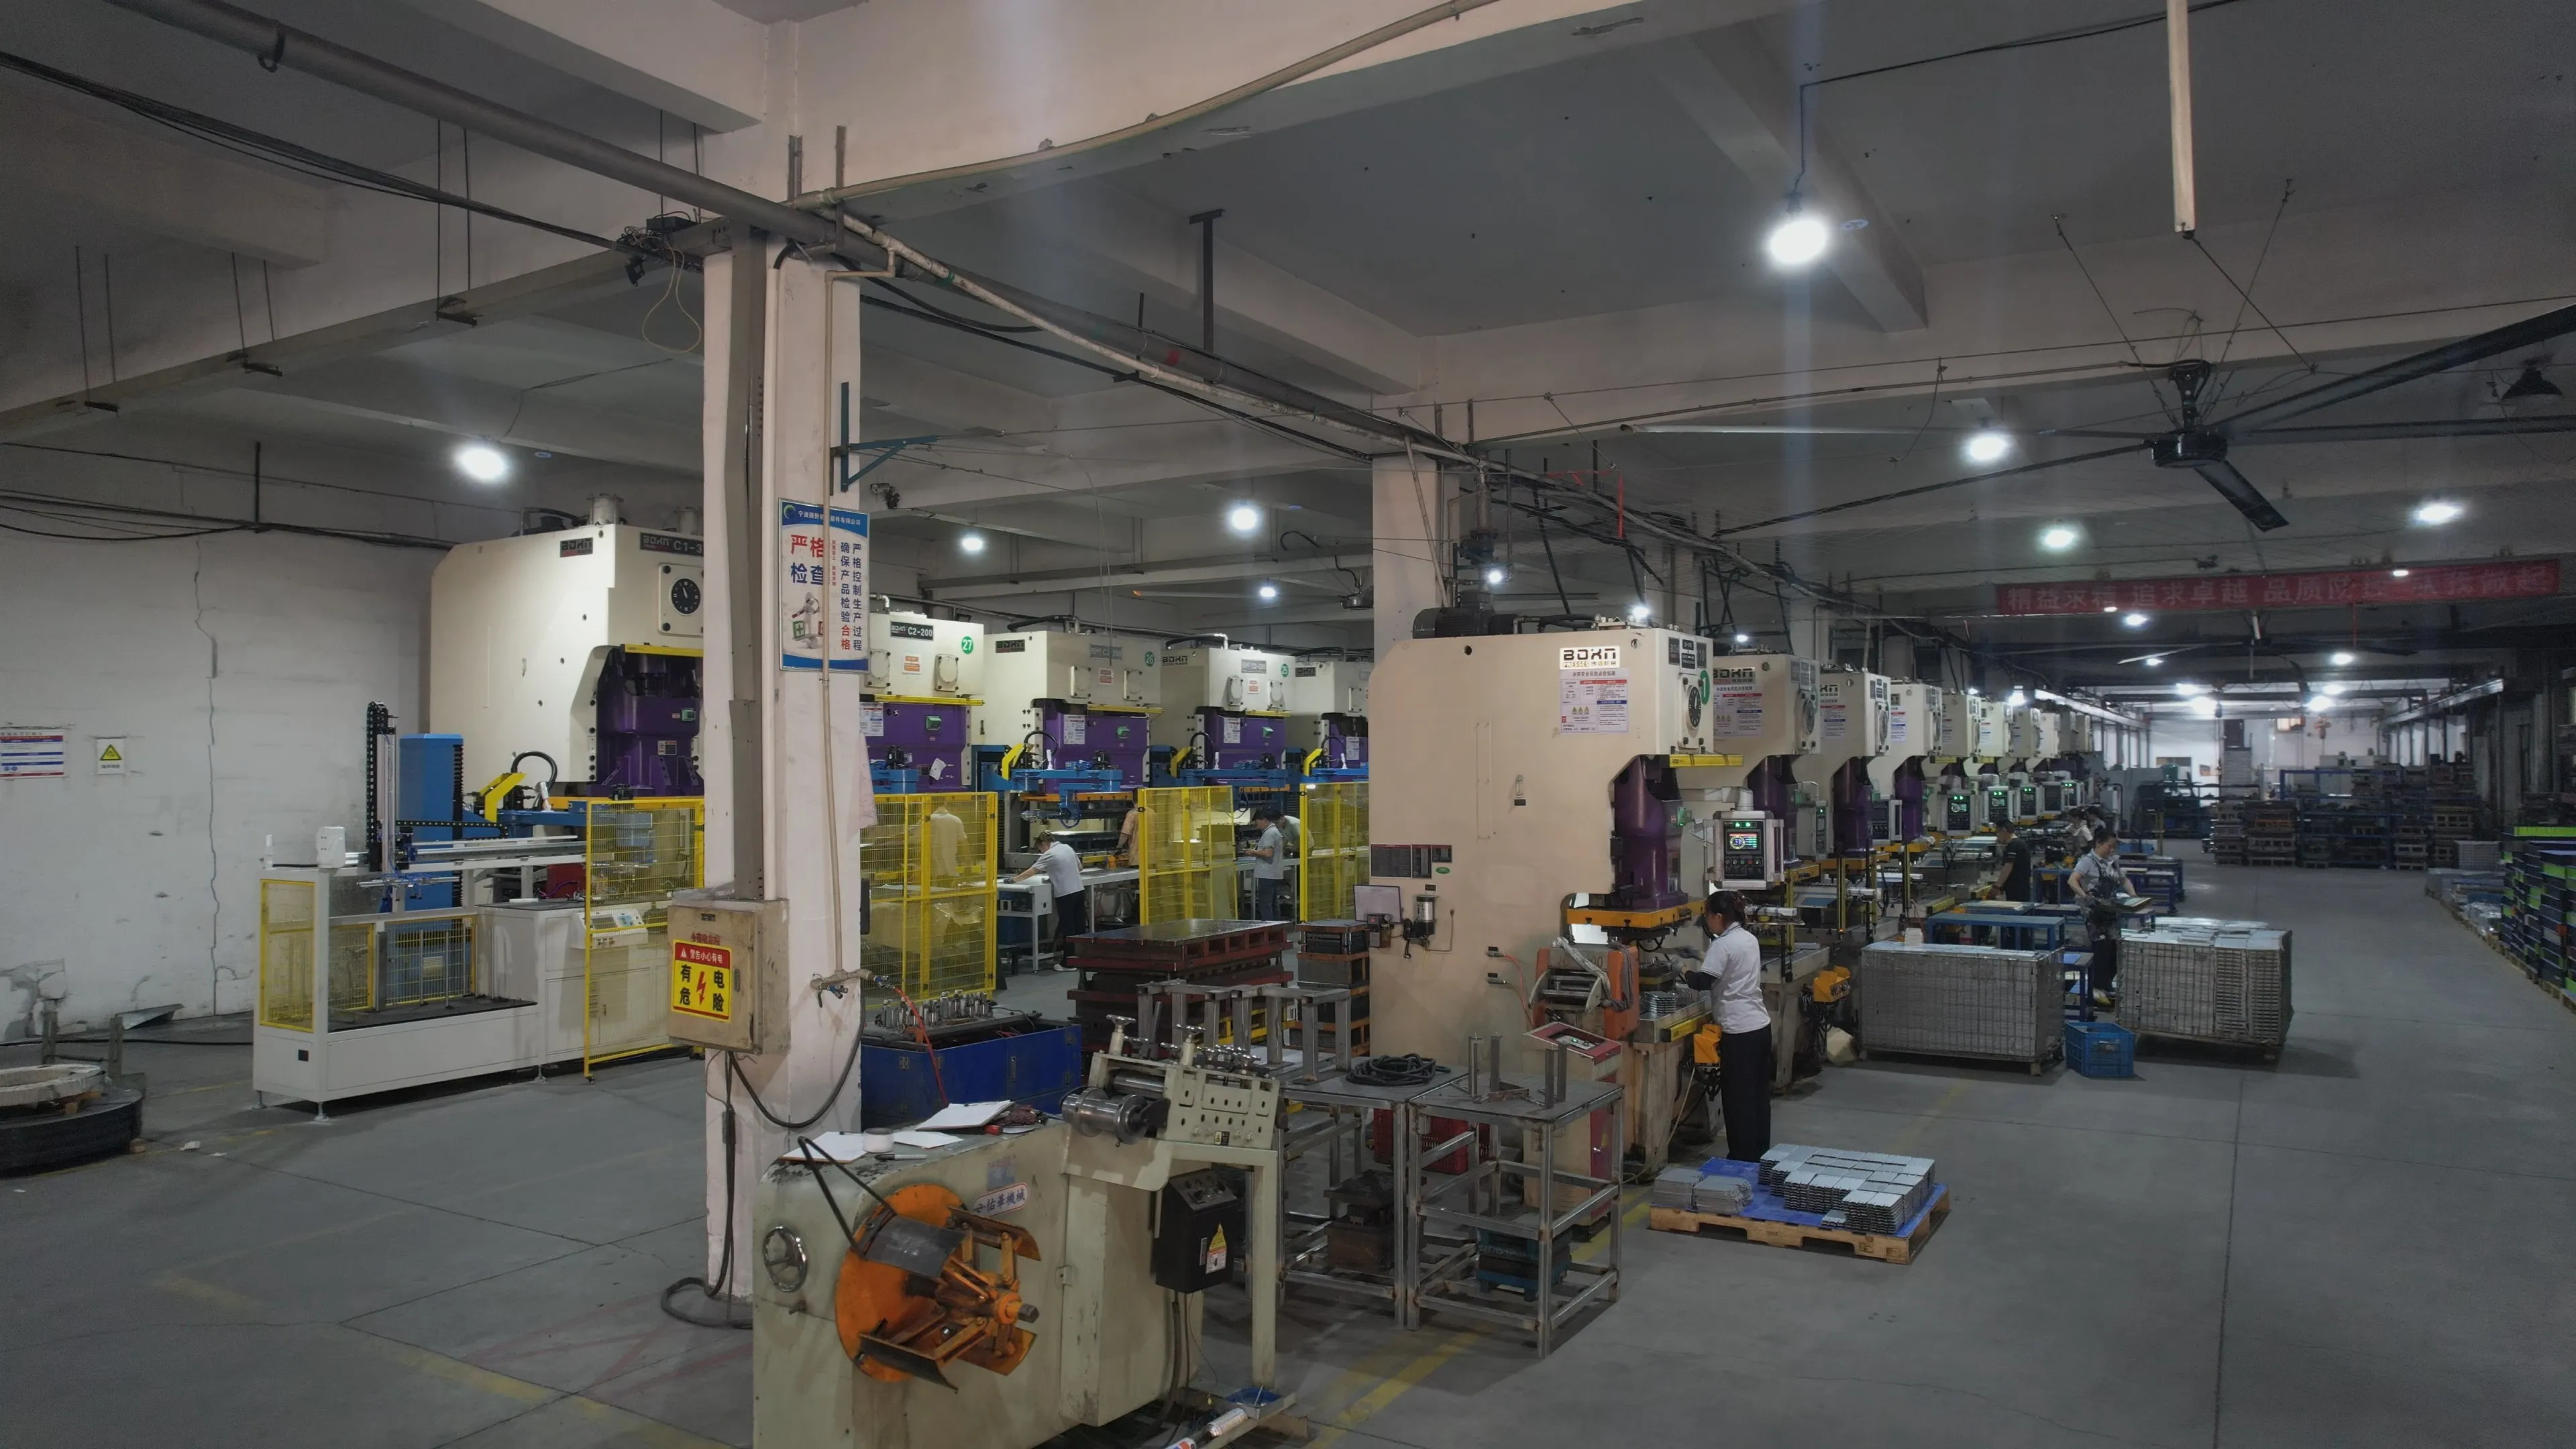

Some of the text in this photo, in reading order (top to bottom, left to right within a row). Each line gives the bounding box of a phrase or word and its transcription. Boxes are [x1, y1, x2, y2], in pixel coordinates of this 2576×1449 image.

[790, 534, 824, 558] 严格
[790, 561, 824, 586] 检查
[840, 541, 851, 651] 确保产品检验合格
[852, 543, 863, 651] 严格控制生产过程
[2131, 579, 2249, 608] 追求卓越
[908, 627, 932, 637] C2-200
[962, 639, 972, 651] 27
[1146, 653, 1155, 665] 26
[1281, 665, 1288, 676] 25
[690, 949, 723, 964] 警告小心有电
[681, 964, 725, 989] 有 电
[679, 987, 724, 1012] 危 险
